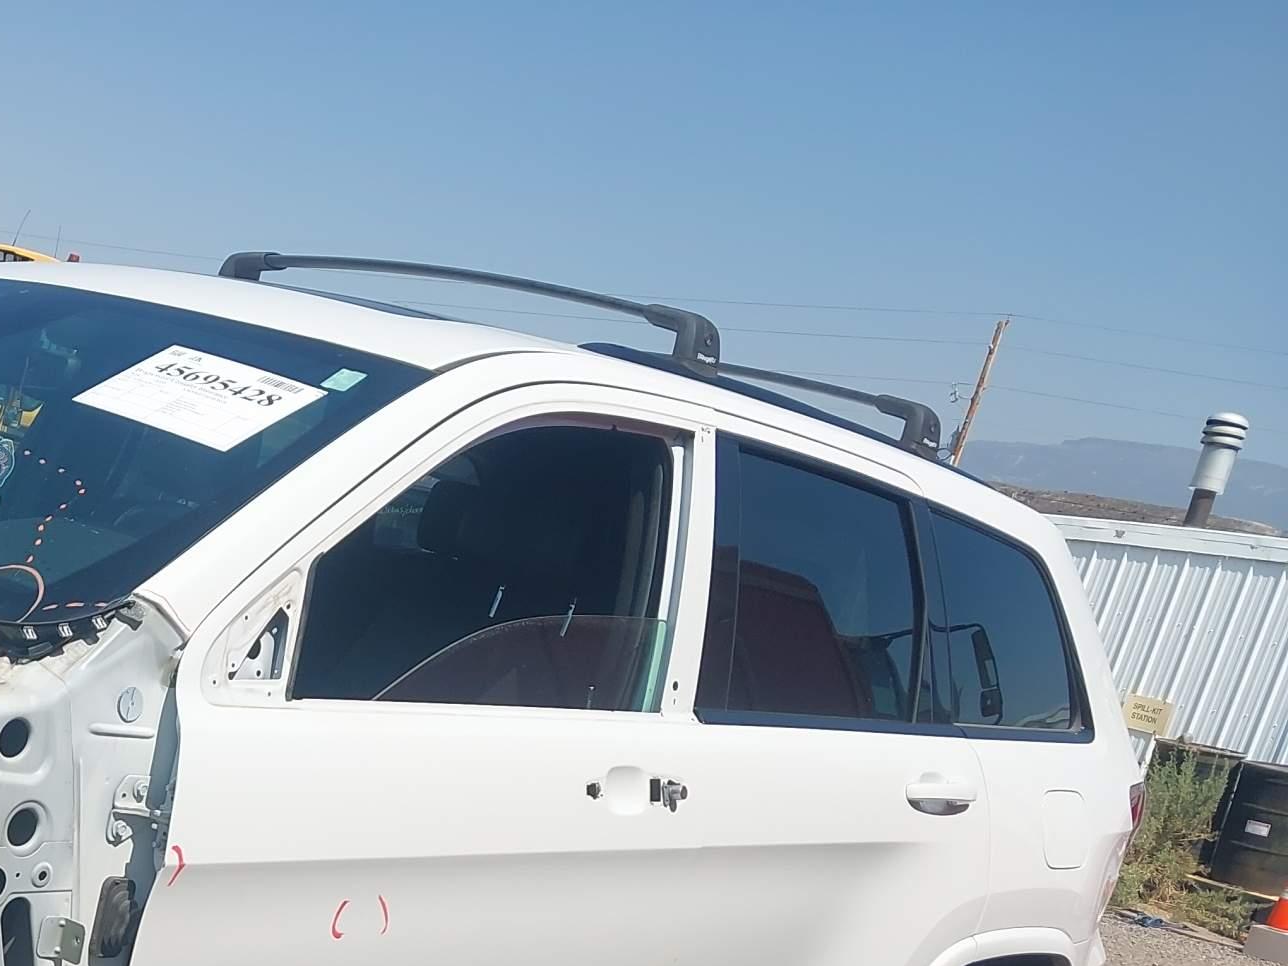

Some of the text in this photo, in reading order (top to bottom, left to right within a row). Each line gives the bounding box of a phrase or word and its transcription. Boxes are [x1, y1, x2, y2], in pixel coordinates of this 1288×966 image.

[154, 363, 283, 407] 45695428
[1132, 702, 1164, 715] SPILL-KIT
[1130, 711, 1158, 724] STATION
